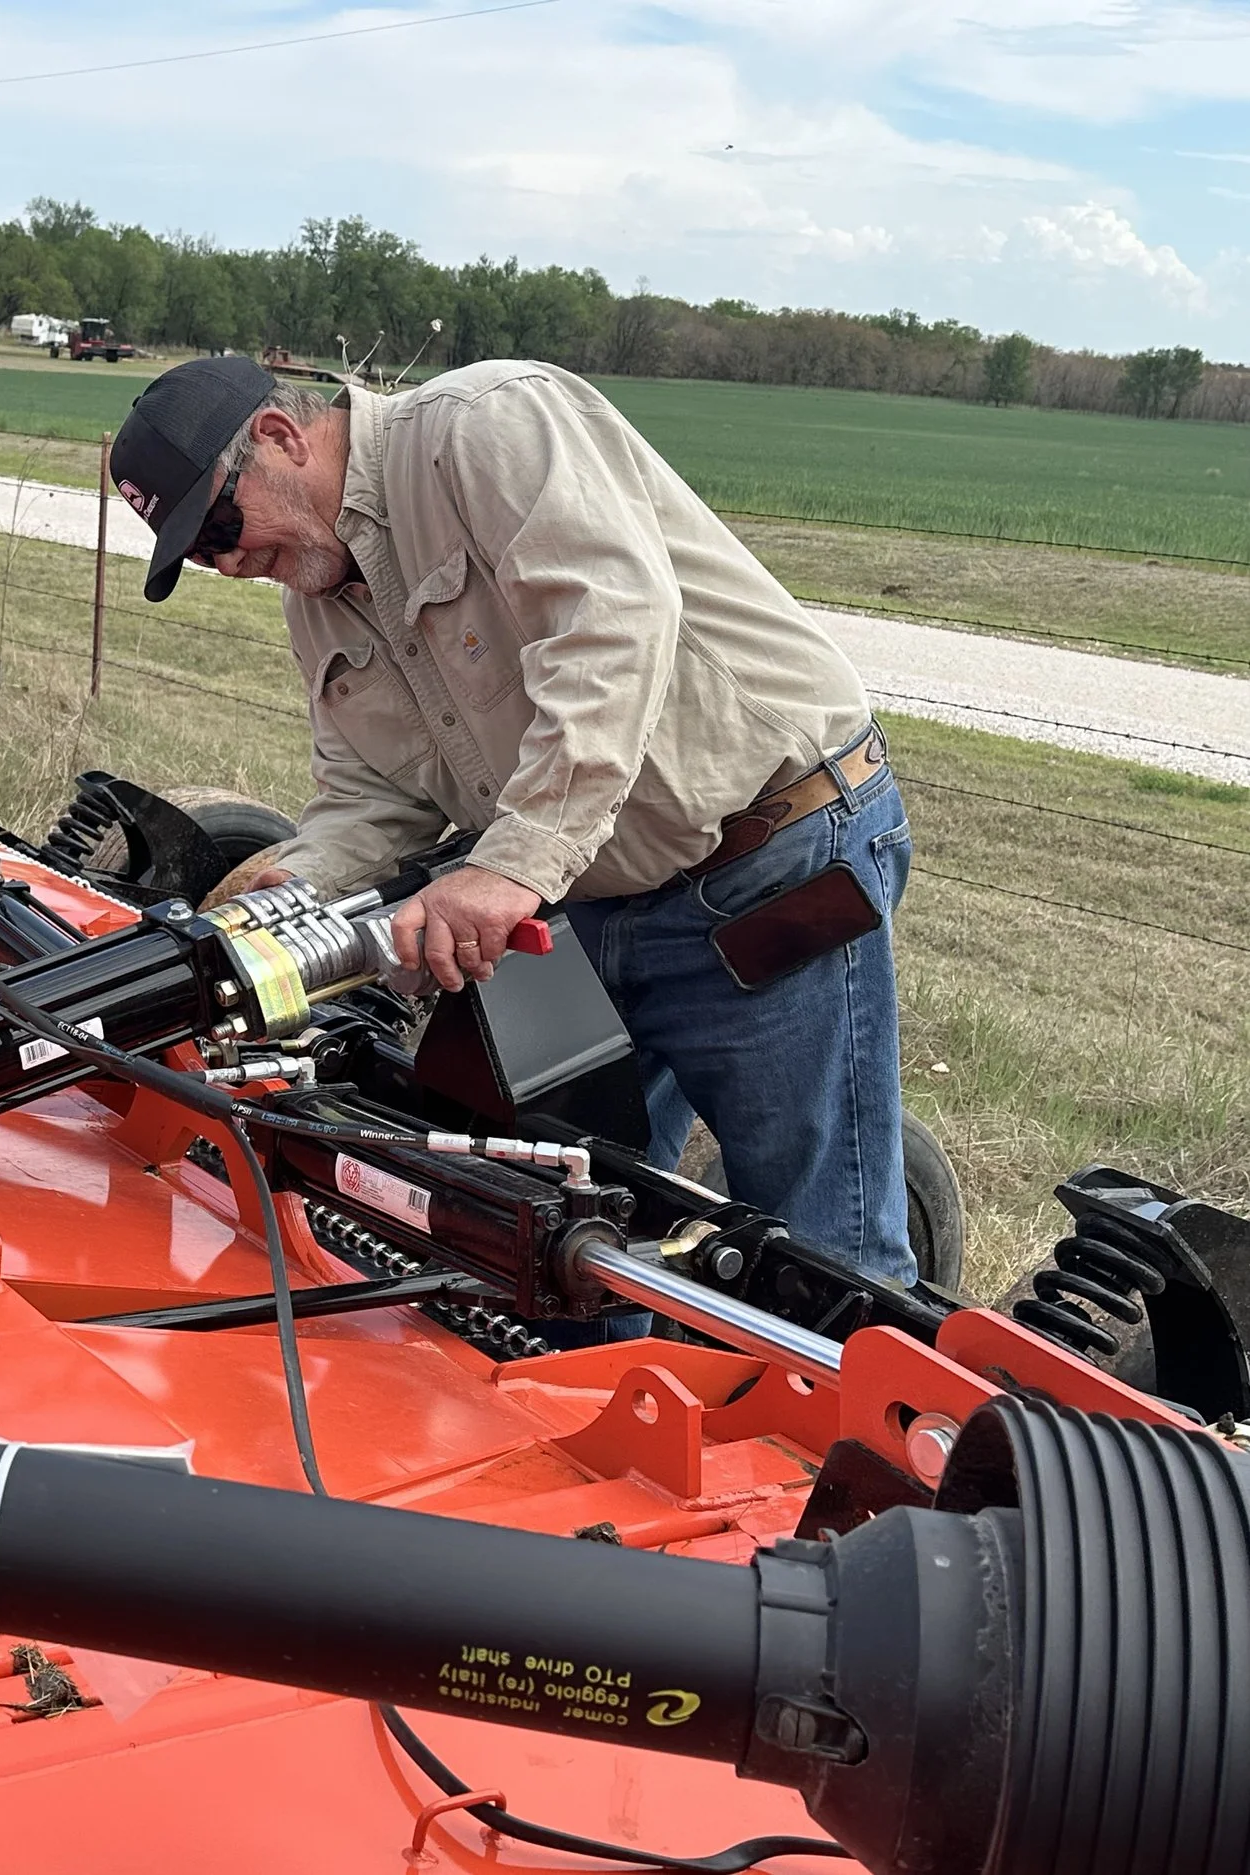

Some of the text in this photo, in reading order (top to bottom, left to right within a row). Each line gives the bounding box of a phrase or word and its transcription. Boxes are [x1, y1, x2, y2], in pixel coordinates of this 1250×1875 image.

[56, 1020, 90, 1042] EC118-04
[359, 1128, 396, 1141] Winner
[438, 1662, 630, 1709] reggiolo (re) italy
[461, 1645, 632, 1688] PTO drive shaft
[438, 1684, 629, 1726] comer industries
